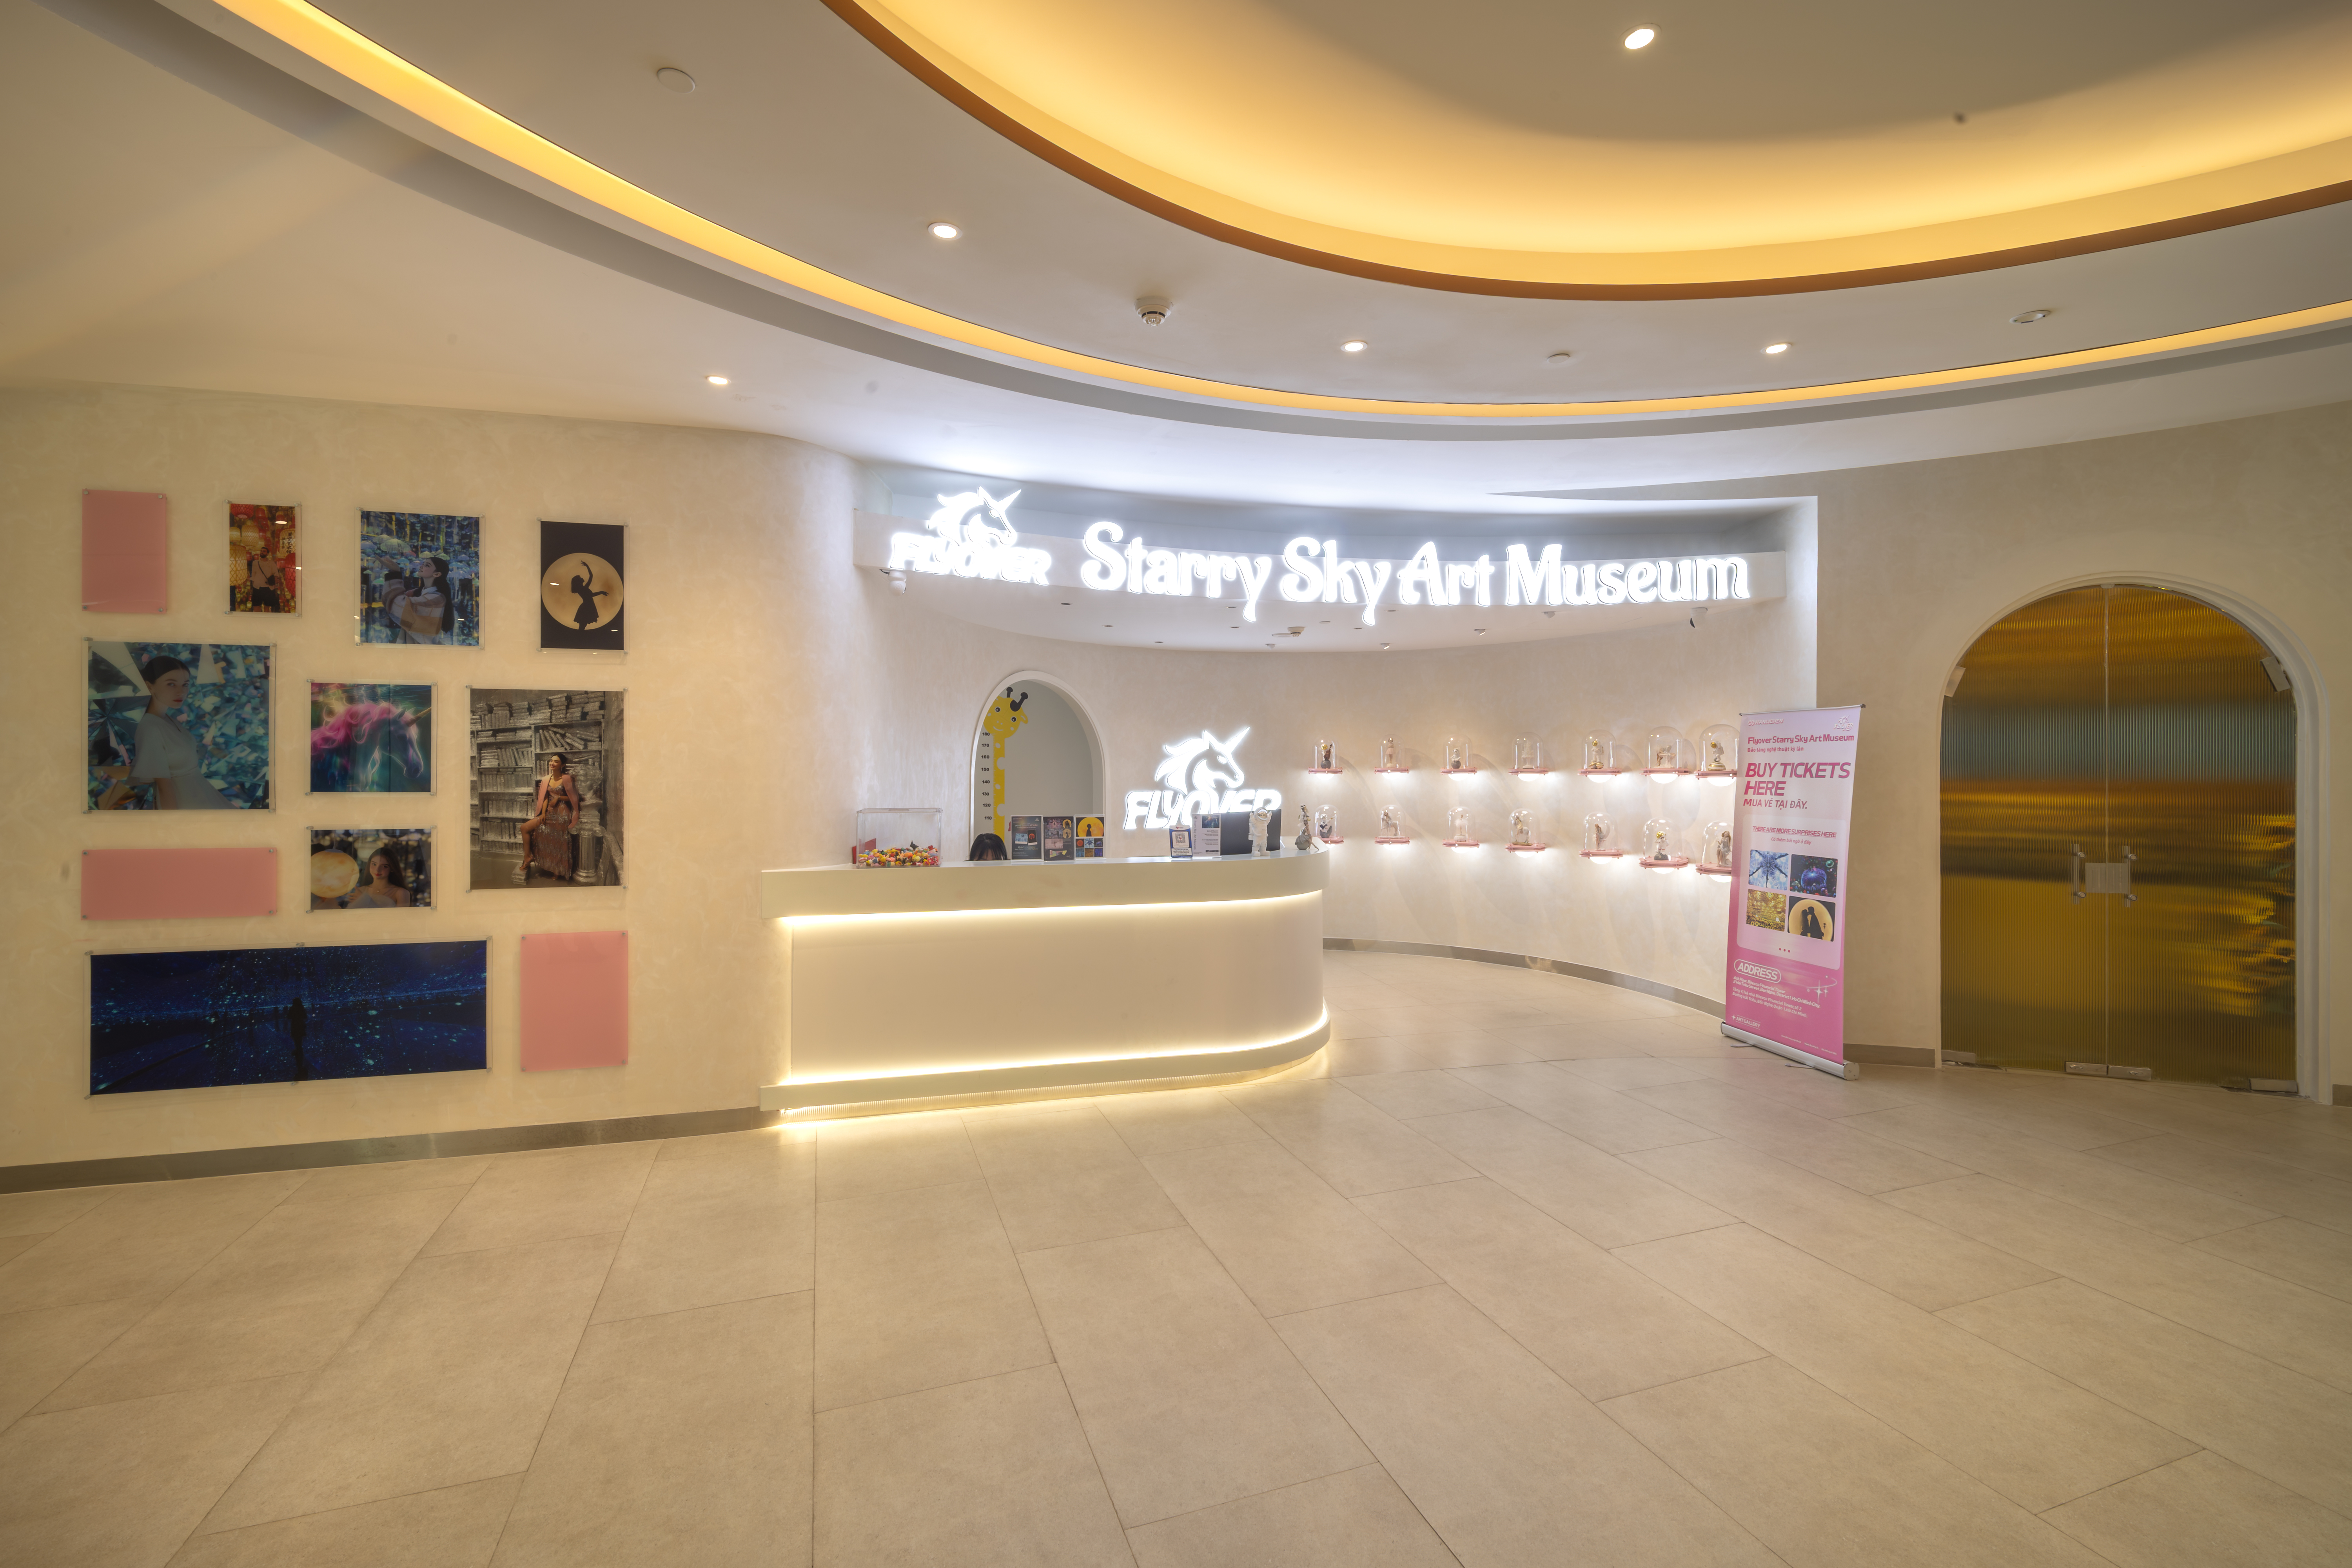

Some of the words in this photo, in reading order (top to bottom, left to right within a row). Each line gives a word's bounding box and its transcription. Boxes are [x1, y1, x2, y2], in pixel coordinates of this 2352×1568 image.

[889, 532, 1052, 586] FLYOVER
[1082, 521, 1272, 622] Starry
[1280, 536, 1392, 626] Sky
[1397, 541, 1495, 607] Art
[1505, 543, 1750, 606] Museum
[1795, 735, 1808, 743] Sky
[1745, 762, 1778, 778] BUY
[1780, 762, 1851, 779] TICKETS
[1744, 780, 1787, 796] HERE
[1743, 799, 1762, 807] MUA
[1764, 798, 1773, 808] VÉ
[1775, 800, 1788, 810] TẠI
[1790, 799, 1808, 809] ĐÂY.
[1737, 962, 1778, 980] ADDRESS
[1744, 1019, 1760, 1027] GALLERY
